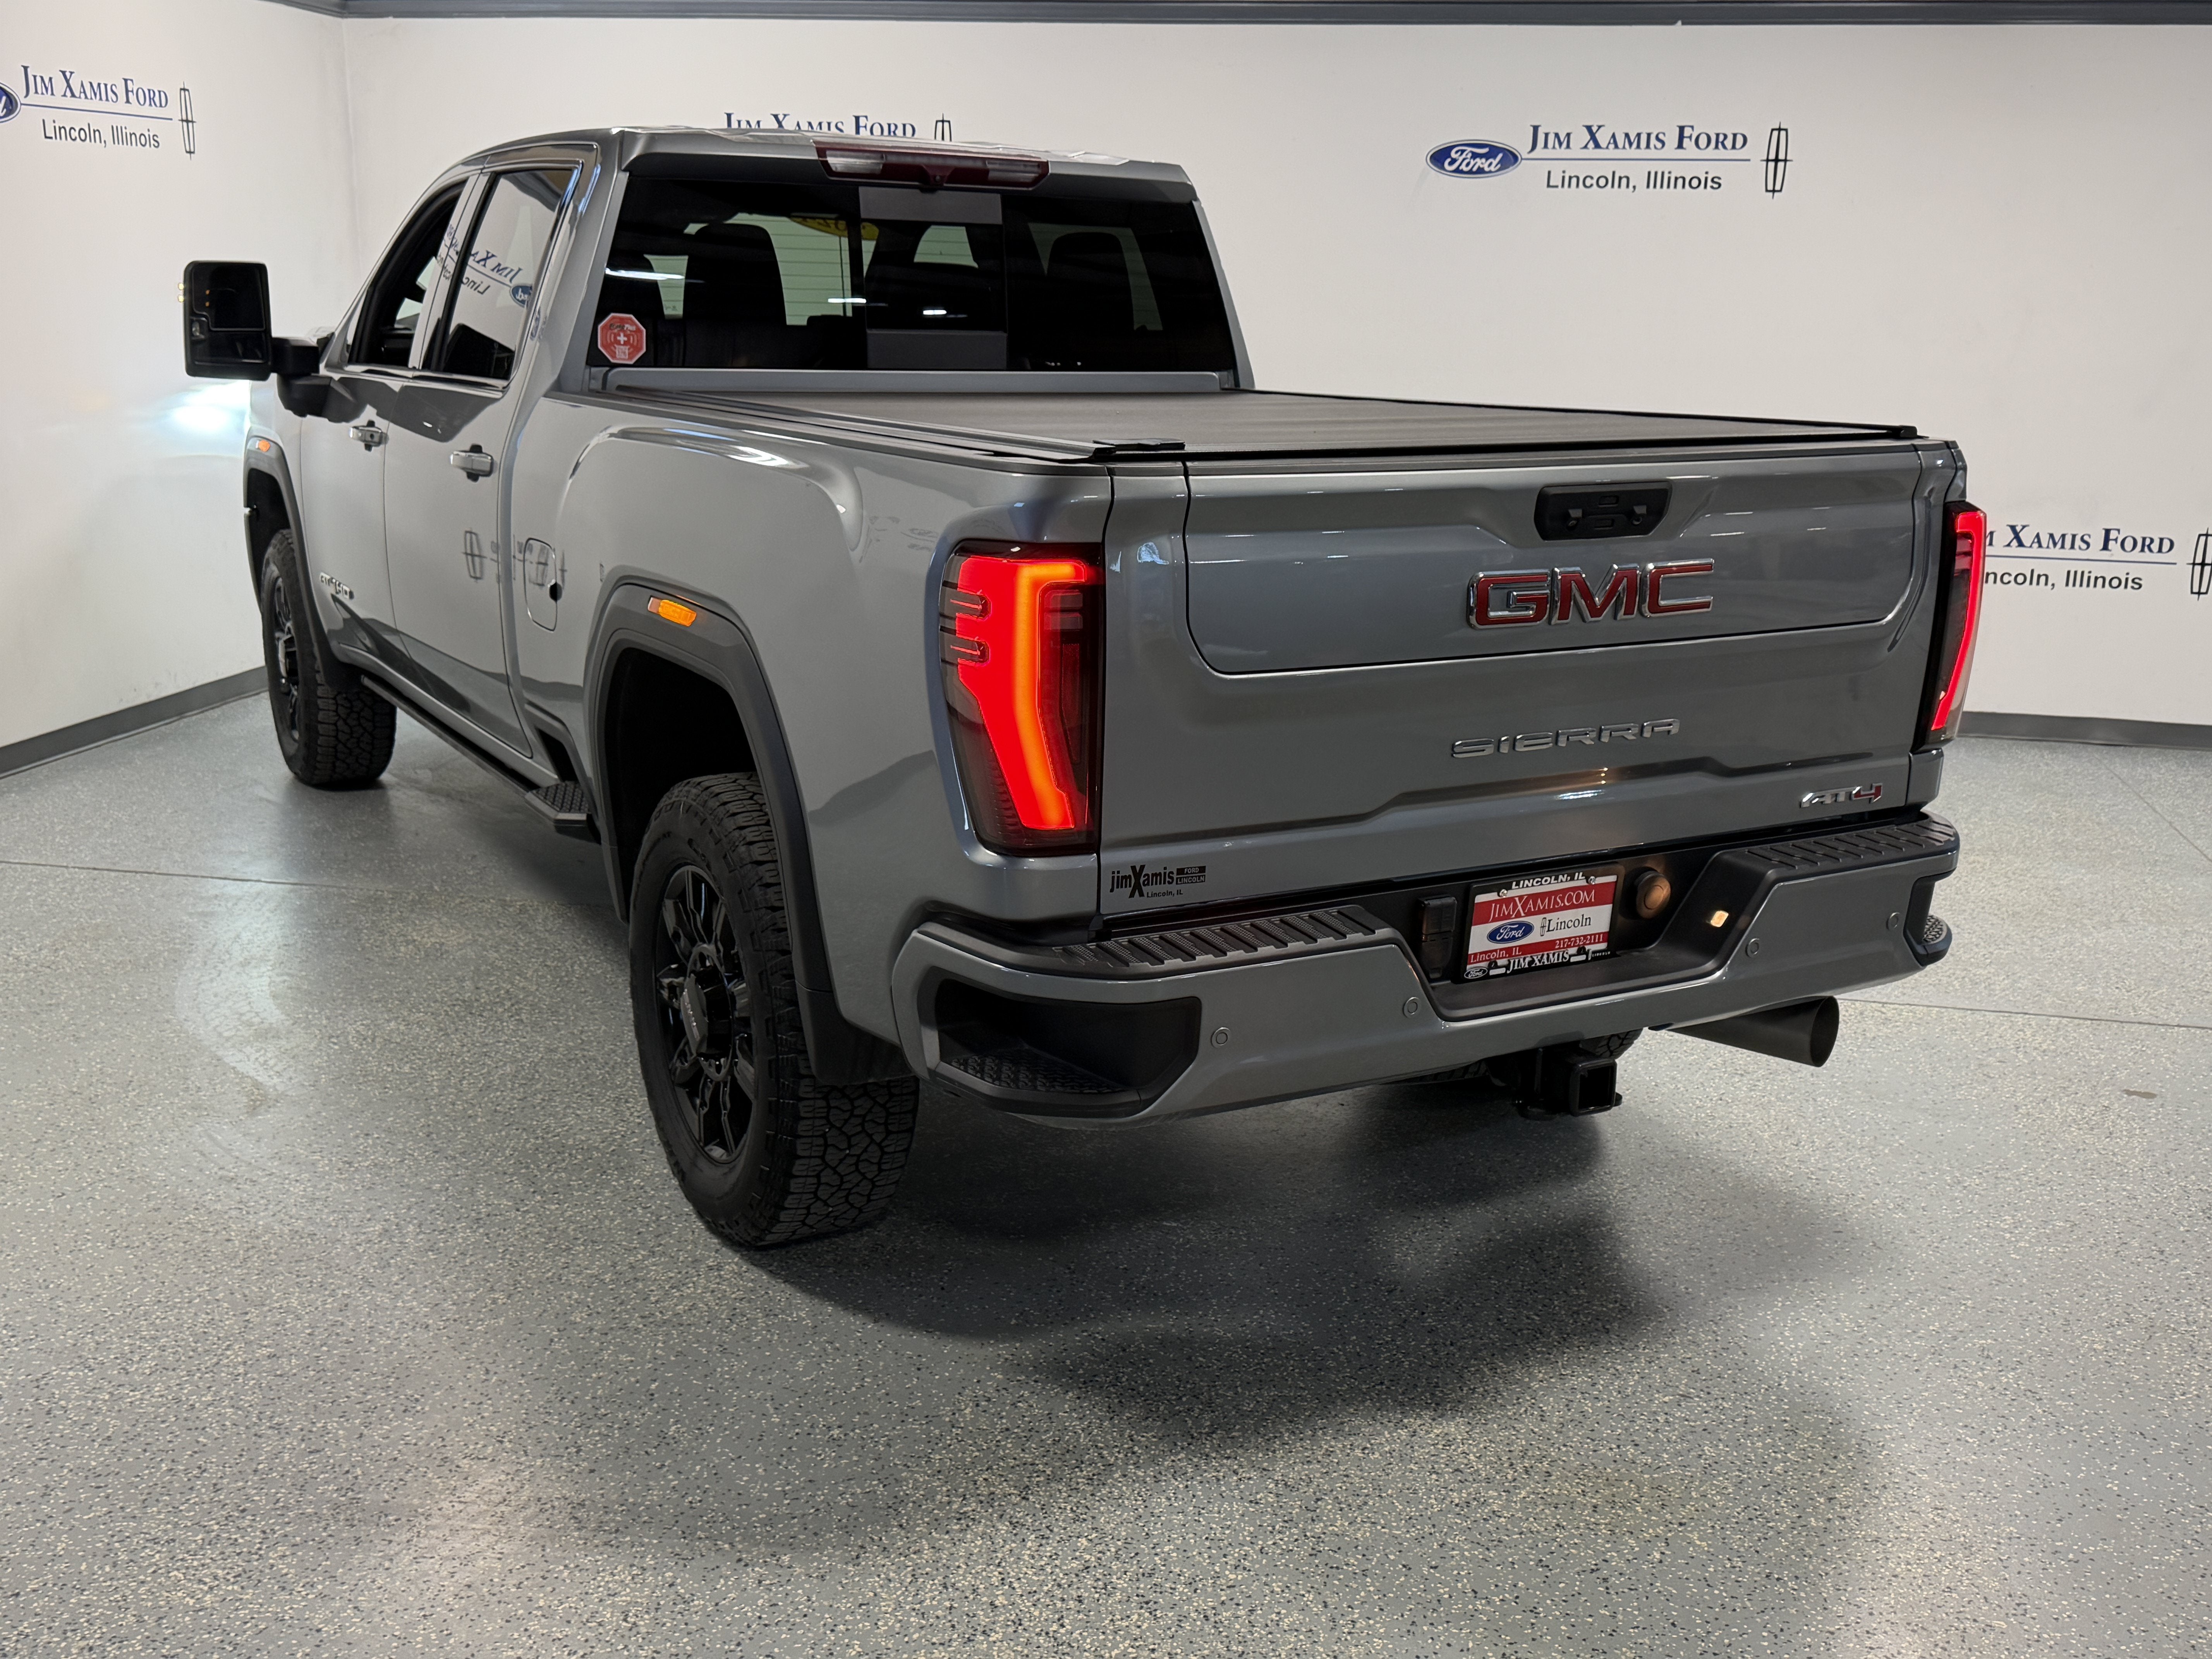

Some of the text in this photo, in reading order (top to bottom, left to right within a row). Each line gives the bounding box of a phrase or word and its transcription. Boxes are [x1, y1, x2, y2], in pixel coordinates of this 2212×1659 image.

[21, 65, 169, 108] JIM XAMIS FORD
[42, 118, 160, 149] Lincoln, Illinois
[852, 115, 916, 137] FORD
[1527, 124, 1748, 154] JIM XAMIS FORD
[1444, 146, 1503, 172] Ford
[1546, 170, 1722, 193] Lincoln, Illinois
[2002, 524, 2091, 551] XAMIS
[2099, 528, 2175, 554] FORD
[1984, 568, 2143, 590] ncoln, Illinois
[1467, 558, 1715, 630] GMC
[1451, 718, 1680, 758] SIERRA
[1800, 783, 1883, 808] AT4
[1110, 864, 1175, 898] jimXamis
[1177, 875, 1205, 884] LINCOLN
[1512, 874, 1570, 890] LINCOLN,
[1489, 890, 1595, 922] JIMXAMIS.COM
[1497, 924, 1525, 939] Ford
[1546, 914, 1591, 932] Lincoln
[1512, 947, 1522, 955] IL
[1555, 934, 1603, 948] 217-732-2111
[1468, 968, 1484, 977] Ford
[1507, 950, 1570, 973] JIM XAMIS
